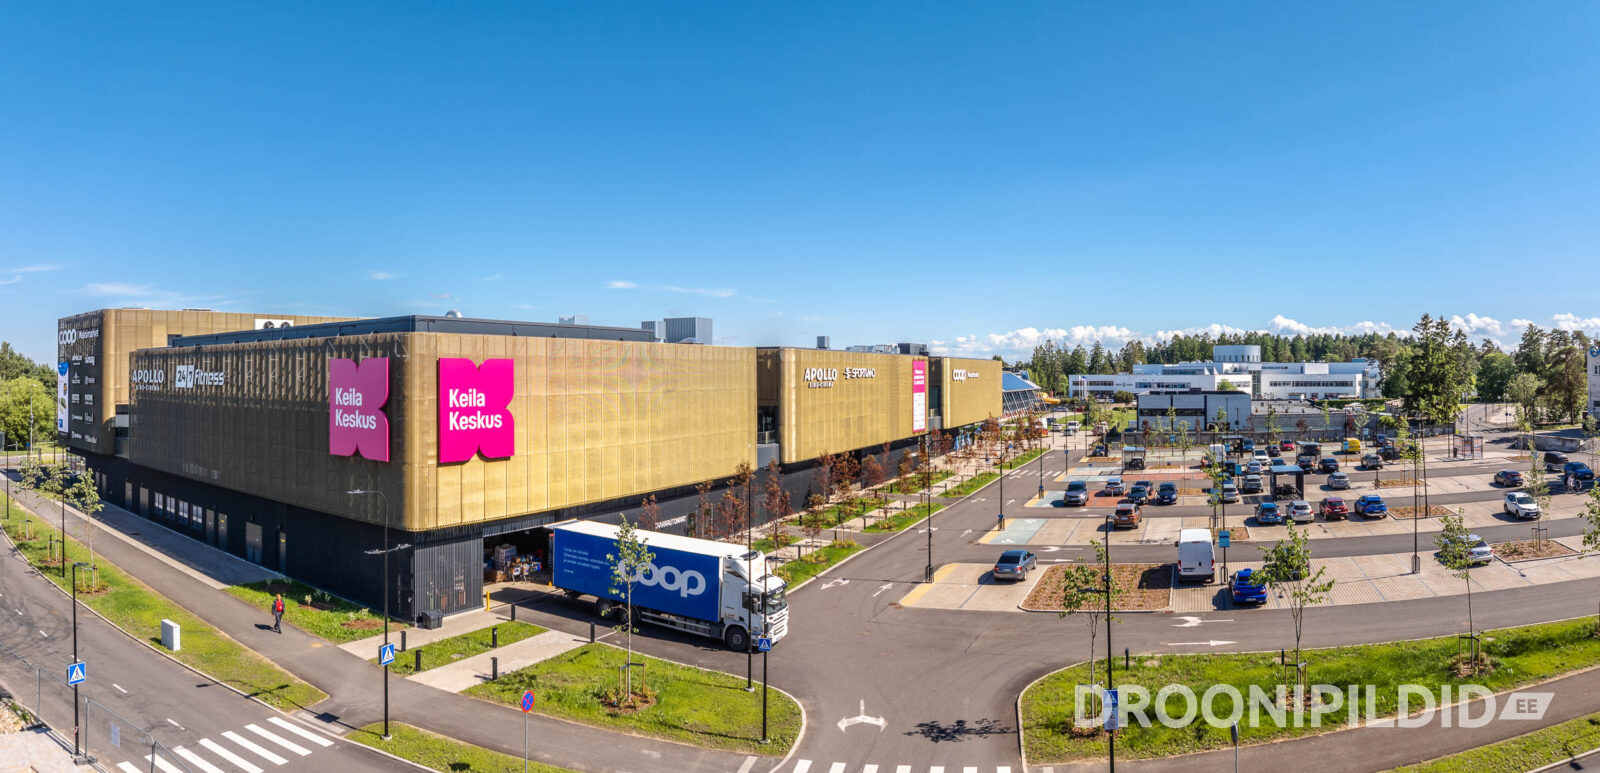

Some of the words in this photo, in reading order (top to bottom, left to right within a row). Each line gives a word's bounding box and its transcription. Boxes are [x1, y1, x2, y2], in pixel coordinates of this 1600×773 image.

[132, 369, 165, 384] APOLLO
[194, 369, 225, 386] fitness
[804, 368, 838, 381] APOLLO
[335, 388, 363, 406] Keila
[449, 389, 486, 408] Keila
[335, 409, 377, 429] Keskus
[449, 411, 503, 431] Keskus
